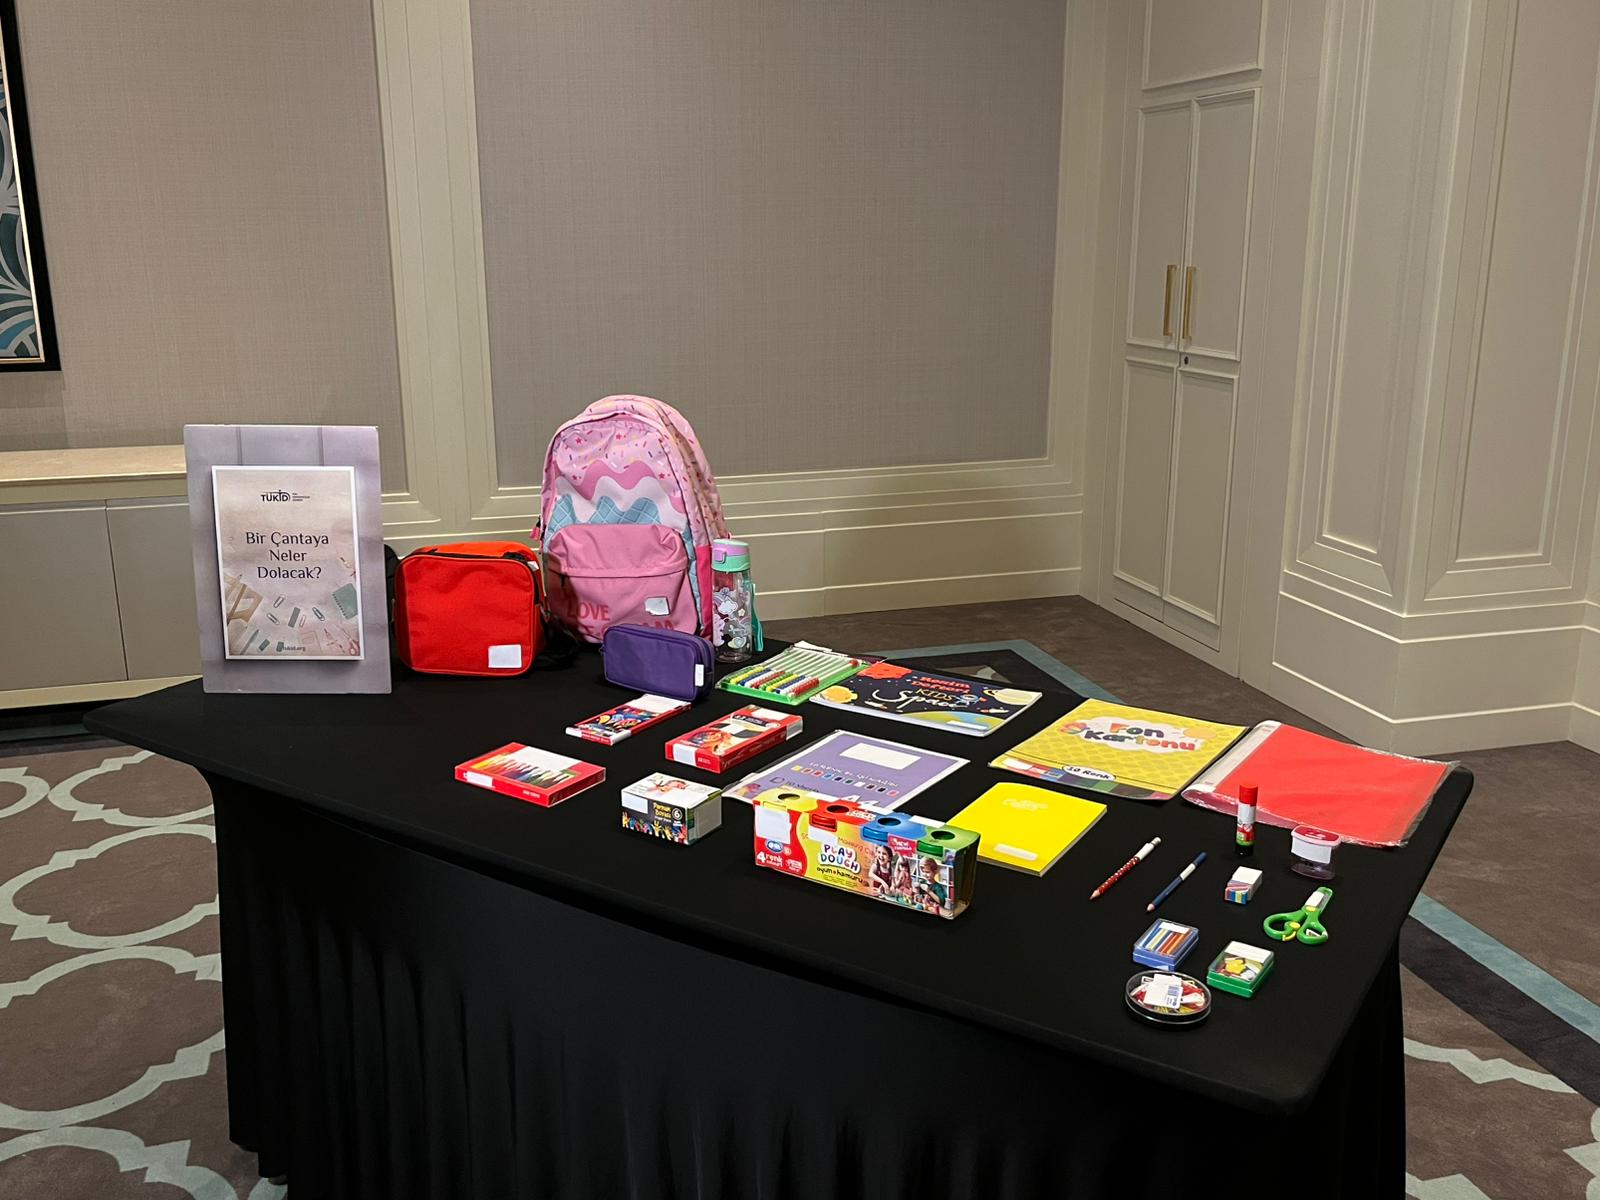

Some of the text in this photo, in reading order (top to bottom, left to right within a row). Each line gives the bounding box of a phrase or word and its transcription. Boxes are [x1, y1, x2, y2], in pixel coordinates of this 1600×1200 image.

[246, 531, 329, 548] Bir Çantaya
[269, 549, 307, 562] Neler
[257, 566, 322, 579] Dolacak?
[567, 601, 610, 622] LOVE
[915, 688, 953, 701] KIDS
[1109, 722, 1165, 738] Fon
[1084, 730, 1196, 751] Kartonu
[1082, 769, 1111, 780] Renk
[757, 851, 766, 863] 4
[824, 844, 853, 858] PLAY
[820, 853, 859, 871] DOUGH
